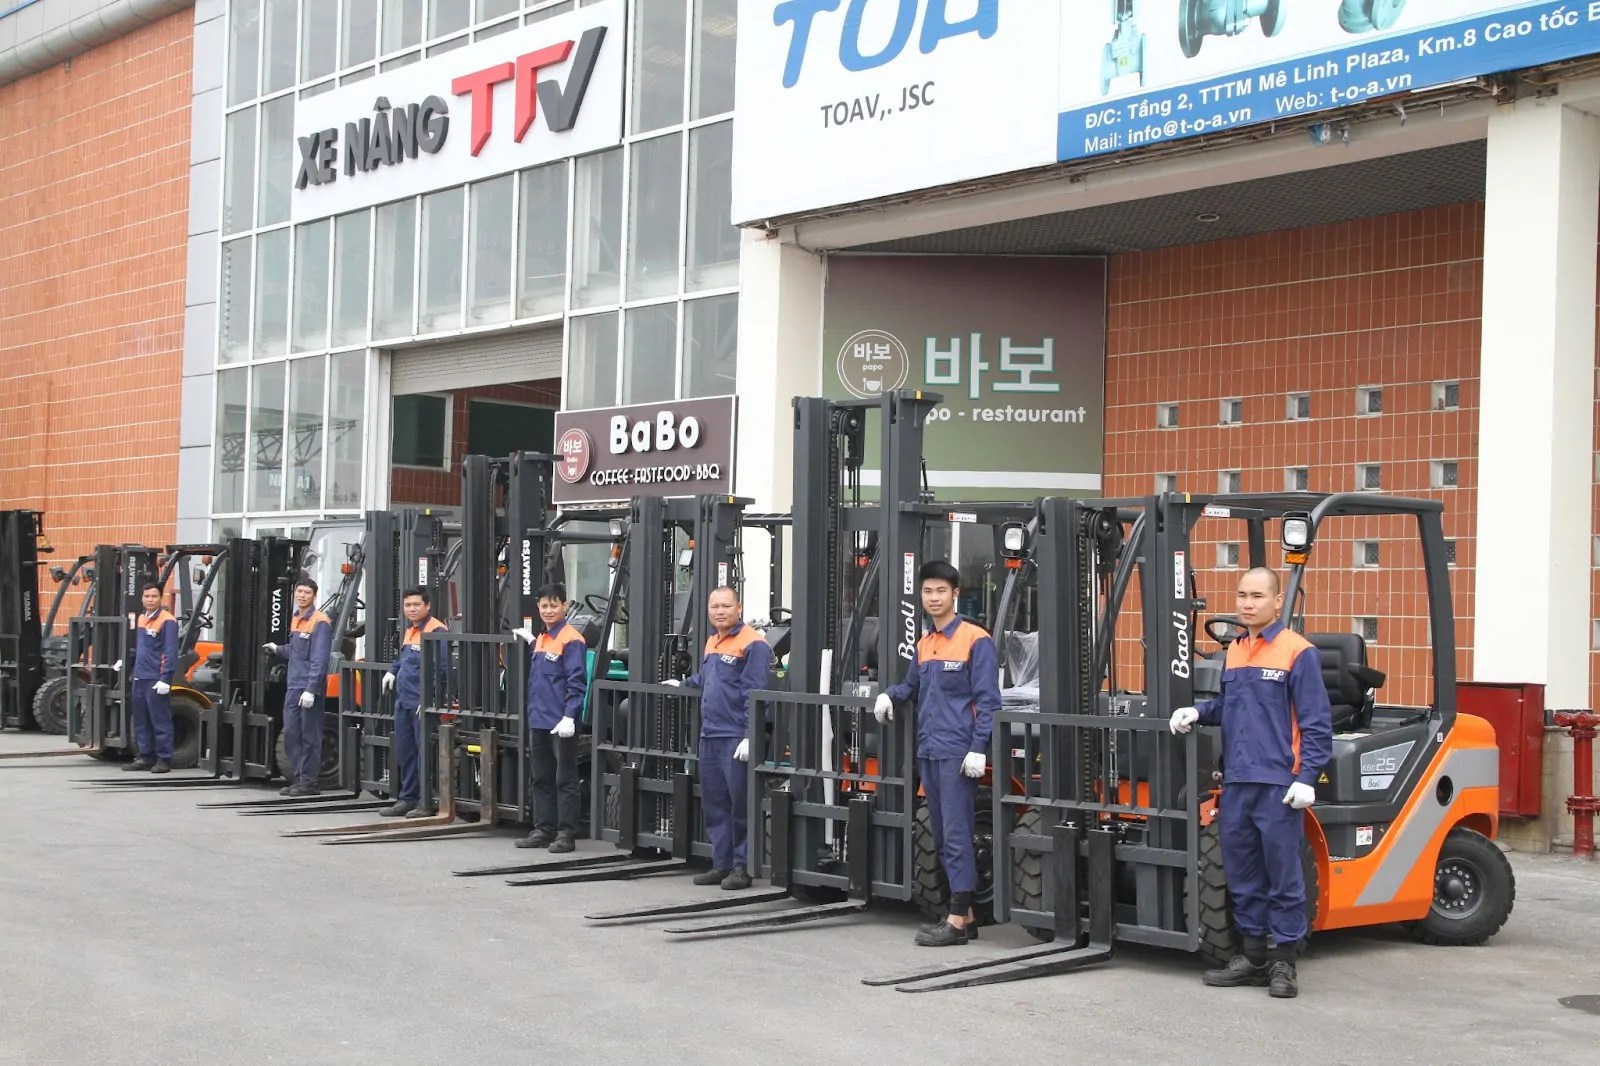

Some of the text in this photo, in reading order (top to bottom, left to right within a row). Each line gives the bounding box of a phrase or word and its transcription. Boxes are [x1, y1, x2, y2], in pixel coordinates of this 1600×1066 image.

[1085, 108, 1122, 130] Đ/C:
[1127, 98, 1172, 120] Tầng
[1177, 94, 1193, 111] 2,
[1199, 78, 1252, 105] TTTM
[1258, 70, 1287, 92] Mê
[1294, 61, 1338, 83] Linh
[1346, 48, 1410, 74] Plaza,
[1418, 29, 1477, 57] Km.8
[1485, 20, 1532, 43] Cao
[1539, 6, 1579, 32] tốc
[295, 26, 607, 189] XE NÂNG TTV
[898, 81, 935, 112] JSC
[1084, 73, 1412, 154] Mail: info@t-o-a.vn Web: t-o-a.vn
[854, 342, 892, 362] 바보
[862, 364, 883, 372] papo
[924, 332, 1060, 400] 바보
[609, 410, 700, 454] BaBo
[972, 405, 1087, 424] restaurant
[563, 439, 583, 455] 바보
[128, 556, 136, 596] KOMATSU
[521, 539, 531, 595] KOMATSU
[271, 588, 282, 633] TOYOTA
